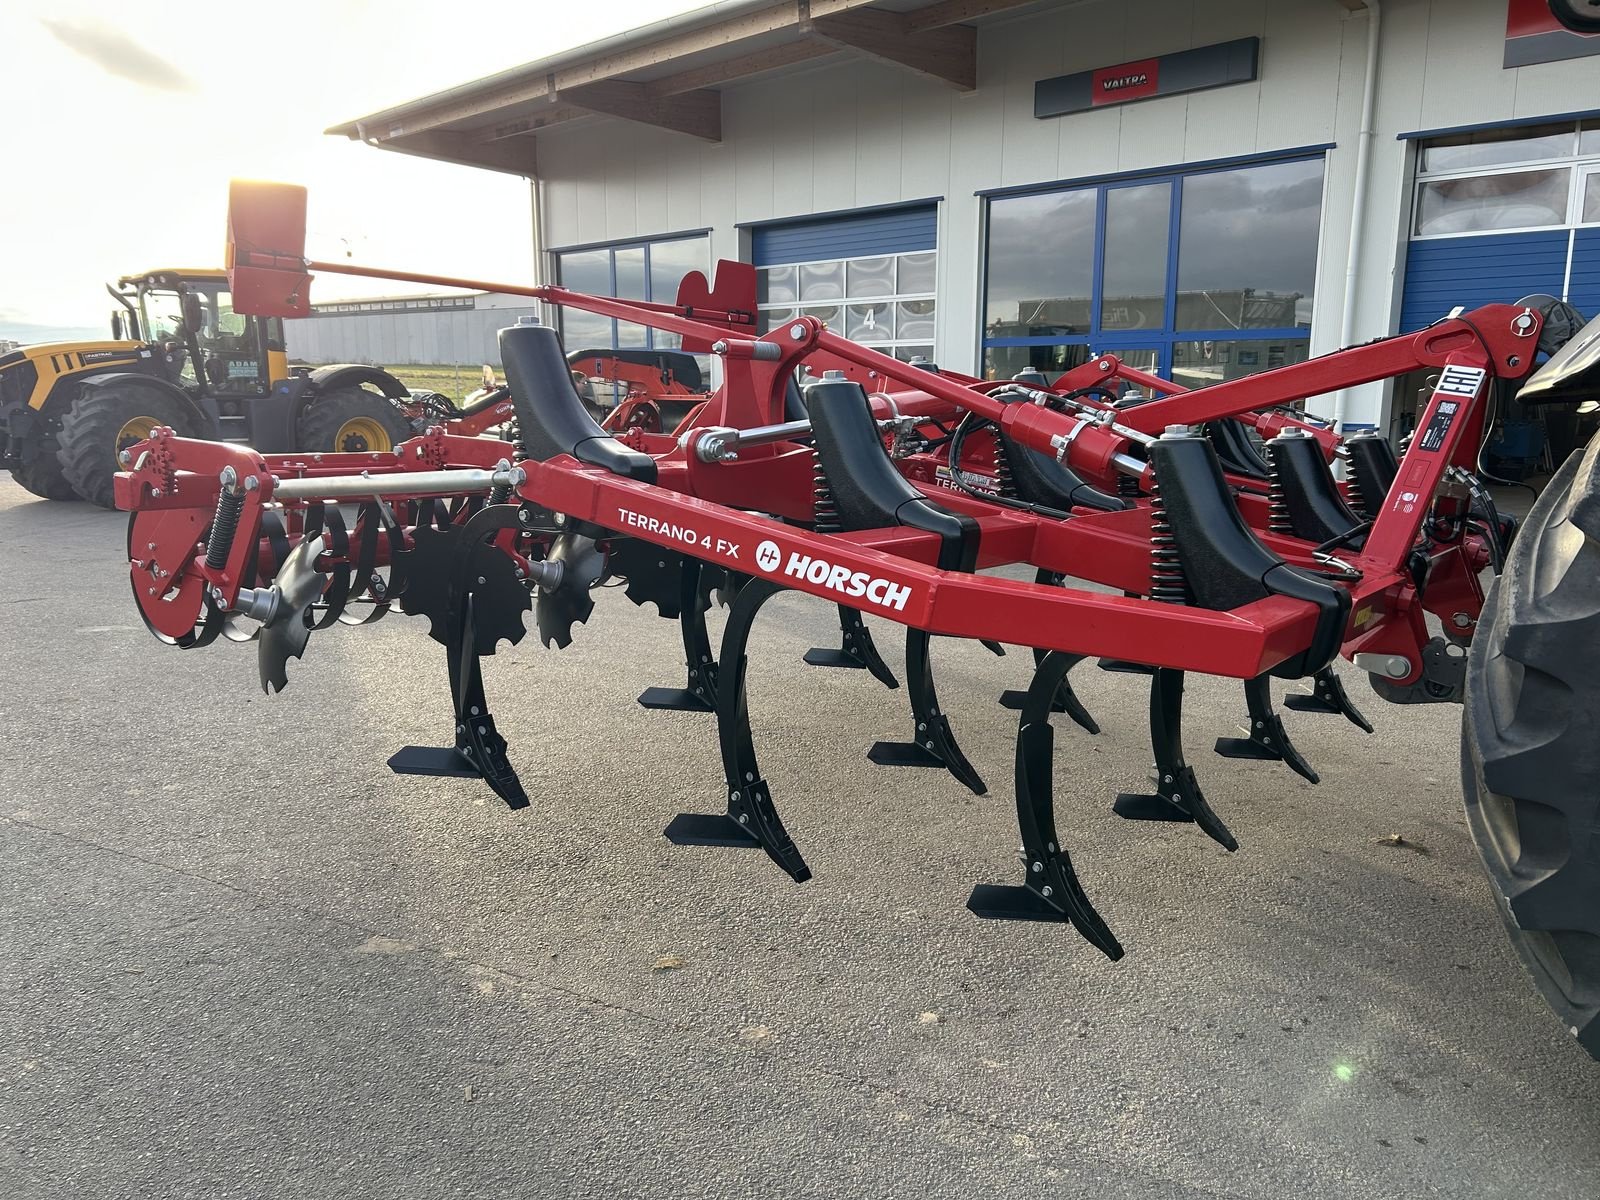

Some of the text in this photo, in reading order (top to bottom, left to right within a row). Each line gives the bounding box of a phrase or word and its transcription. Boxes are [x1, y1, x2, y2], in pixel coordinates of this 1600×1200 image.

[1103, 74, 1147, 90] VALTRA
[863, 308, 876, 330] 4
[257, 386, 263, 394] 5
[935, 477, 998, 497] TERO
[618, 508, 740, 559] TERRANO 4 FX
[784, 551, 913, 612] HORSCH
